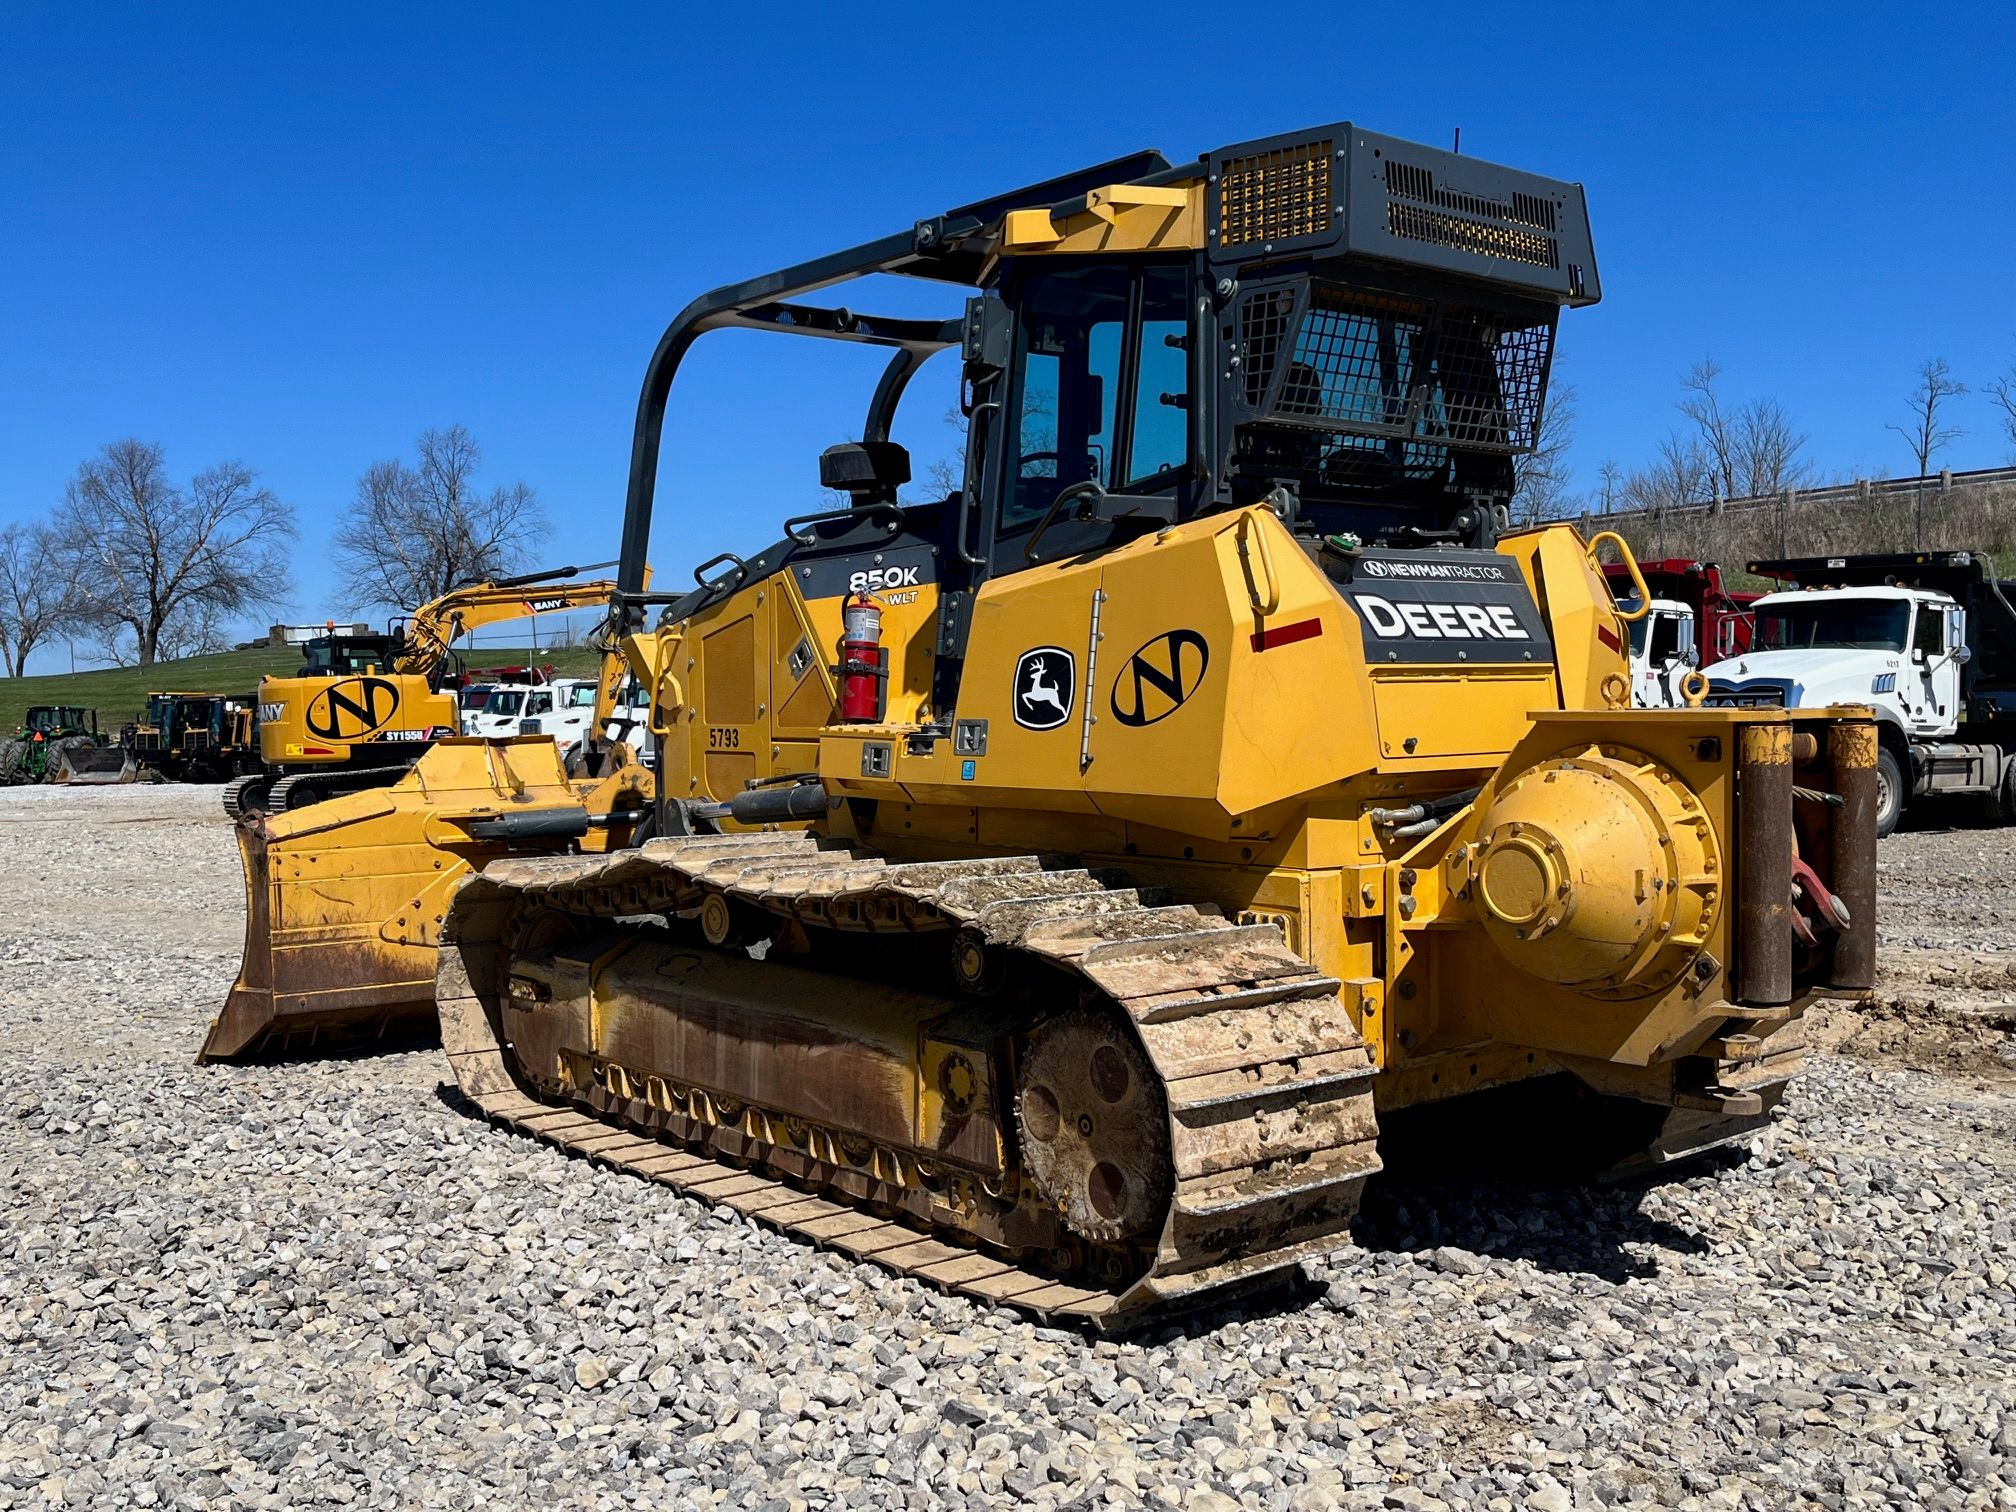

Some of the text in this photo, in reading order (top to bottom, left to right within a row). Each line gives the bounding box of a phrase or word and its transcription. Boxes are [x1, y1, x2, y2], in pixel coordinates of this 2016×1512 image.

[849, 566, 919, 593] 850K
[533, 600, 562, 611] SANY
[889, 591, 918, 606] WLT
[1353, 594, 1530, 639] DEERE
[258, 703, 286, 721] ANY
[386, 730, 423, 741] SY155U
[709, 728, 739, 748] 5793
